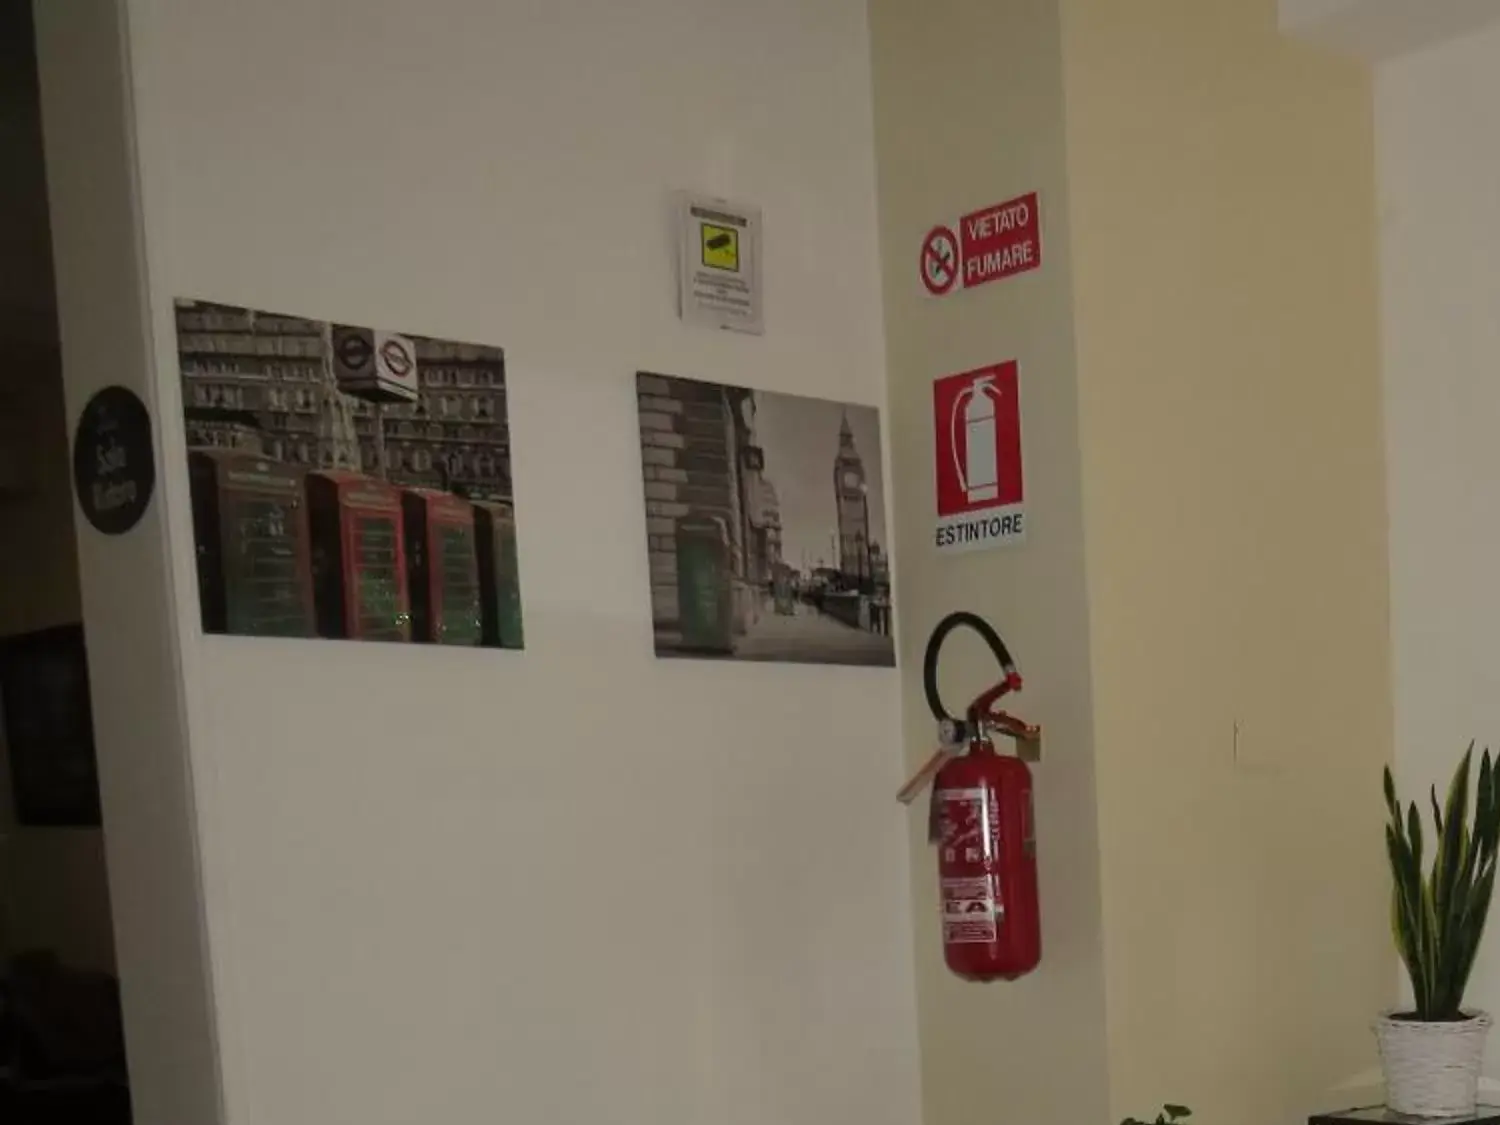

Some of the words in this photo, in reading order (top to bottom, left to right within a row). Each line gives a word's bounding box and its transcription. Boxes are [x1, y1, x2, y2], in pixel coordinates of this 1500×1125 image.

[967, 203, 1029, 240] VIETATO
[967, 240, 1034, 281] FUMARE
[935, 513, 1023, 547] ESTINTORE
